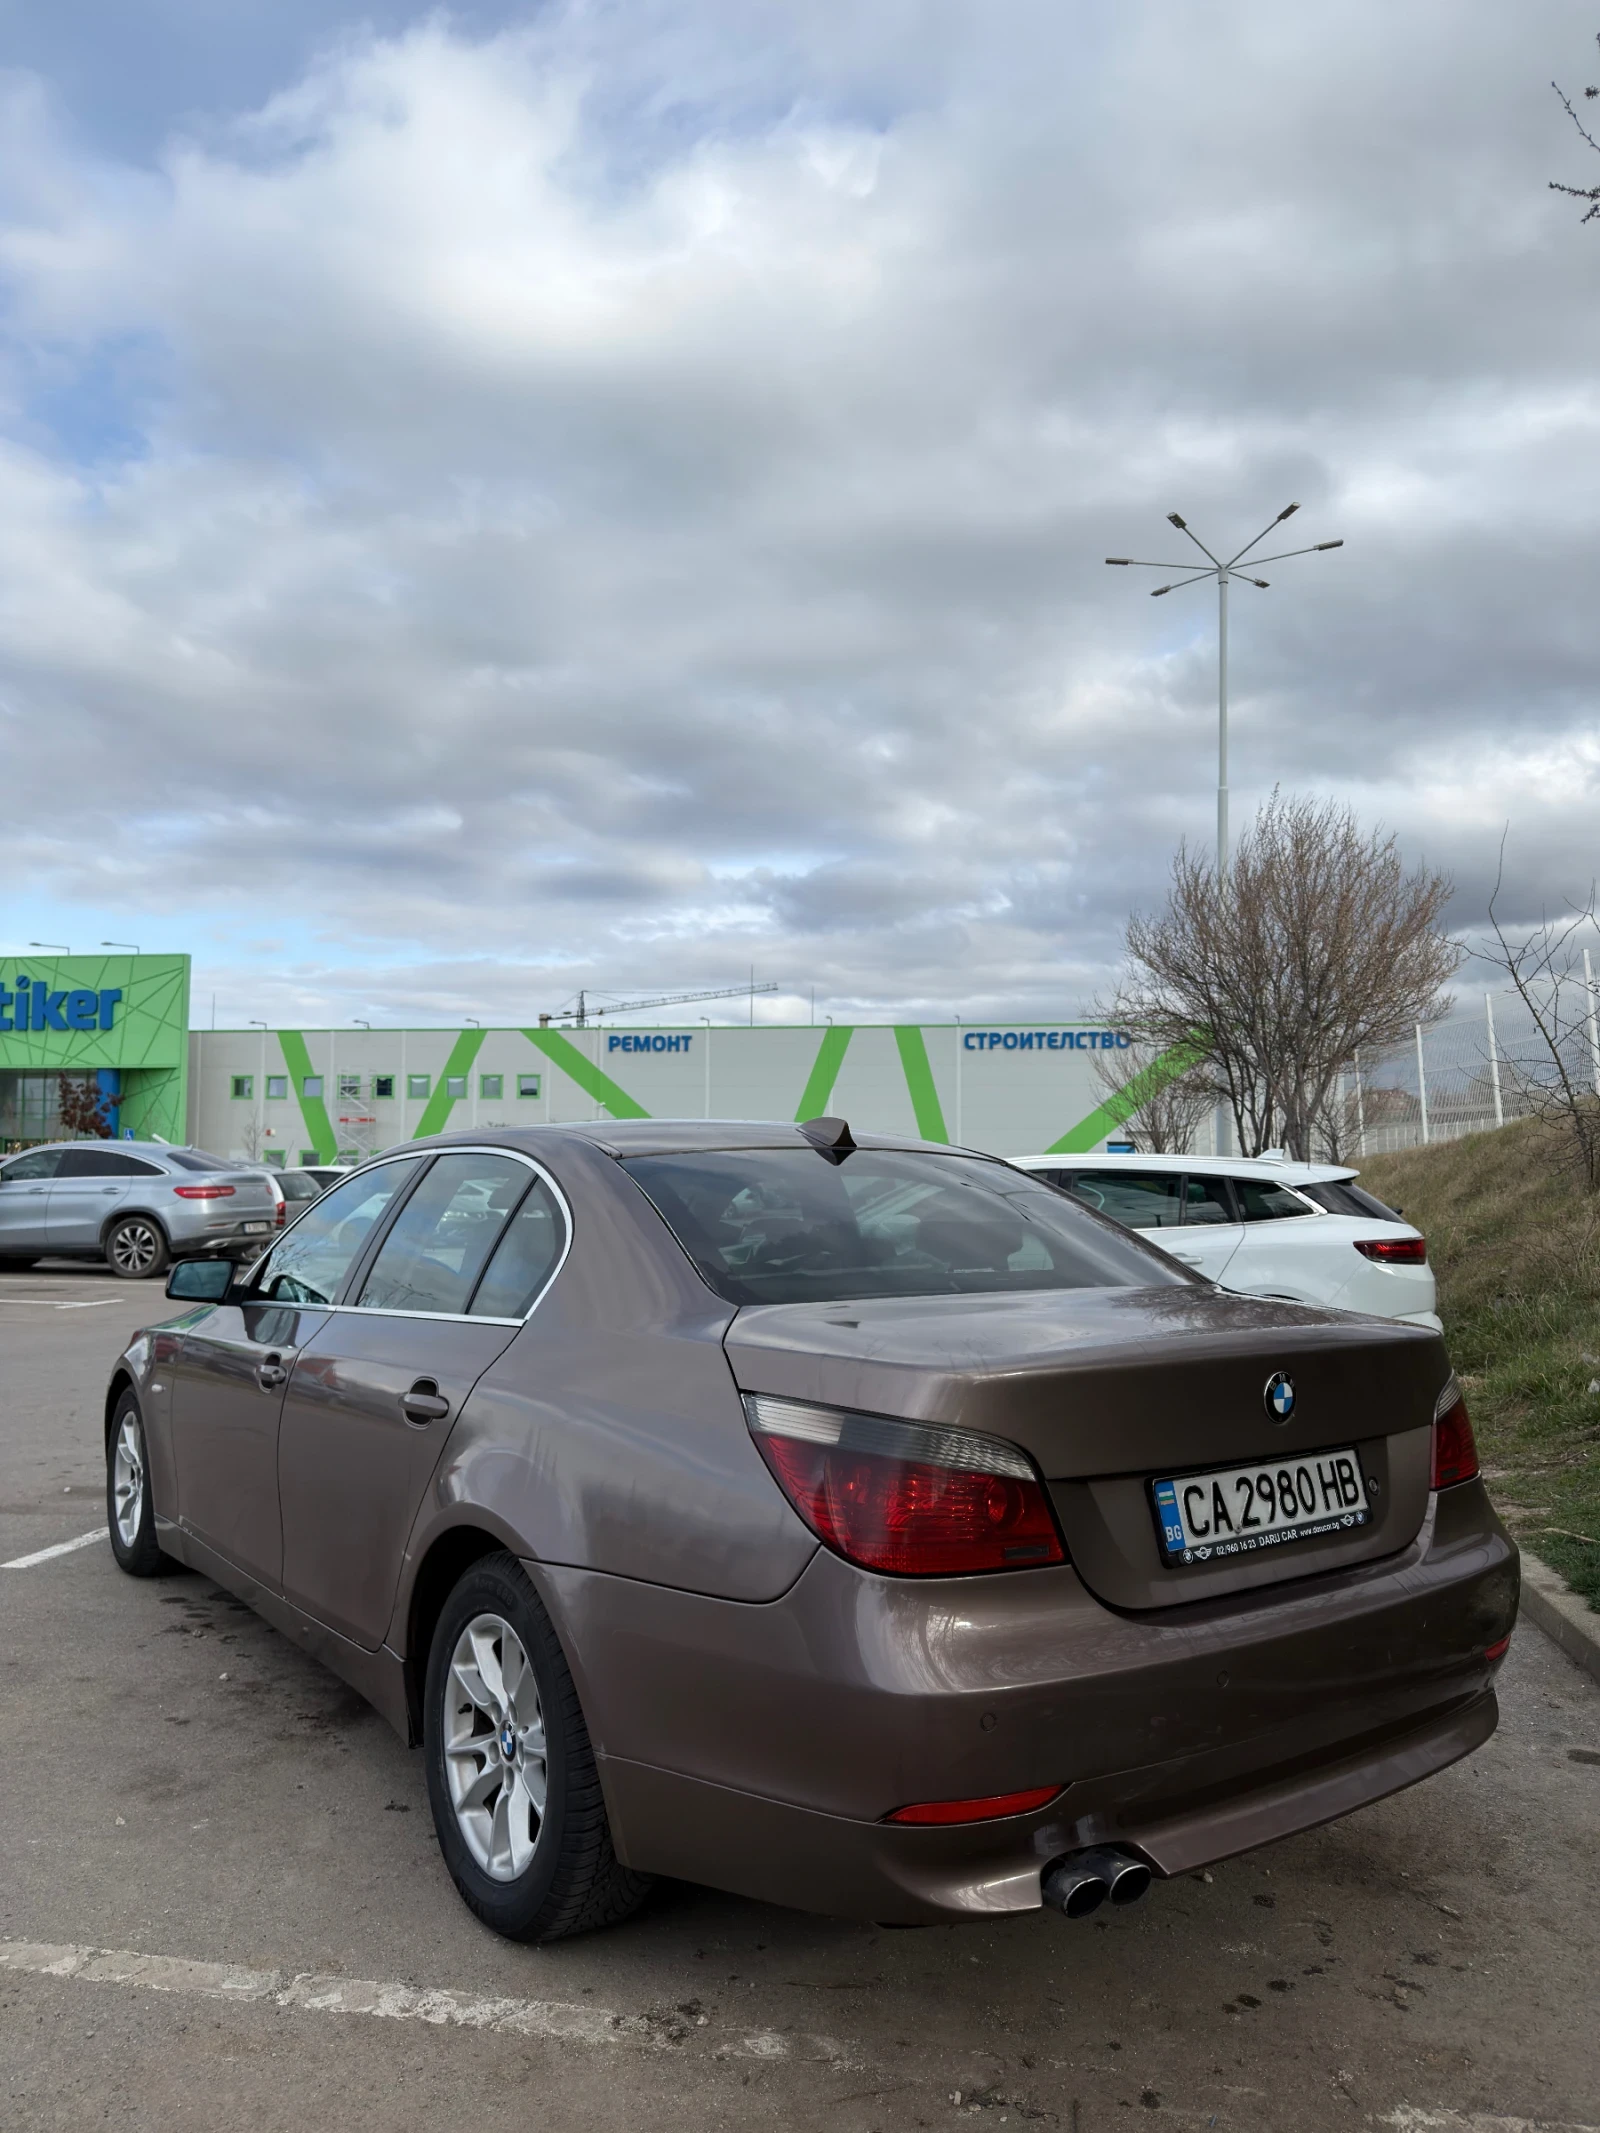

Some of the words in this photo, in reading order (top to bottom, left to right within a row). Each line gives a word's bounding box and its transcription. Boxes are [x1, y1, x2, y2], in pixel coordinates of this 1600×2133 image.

[608, 1035, 692, 1052] РЕМОНТ
[964, 1032, 1131, 1050] СТРОИТЕЛСТВО
[1183, 1480, 1234, 1538] CA
[1236, 1466, 1316, 1528] 2980
[1316, 1458, 1360, 1511] HB
[1166, 1526, 1182, 1541] BG
[1239, 1541, 1248, 1551] 16
[1247, 1539, 1257, 1549] 23
[1258, 1533, 1280, 1547] DARU
[1281, 1529, 1298, 1541] CAR
